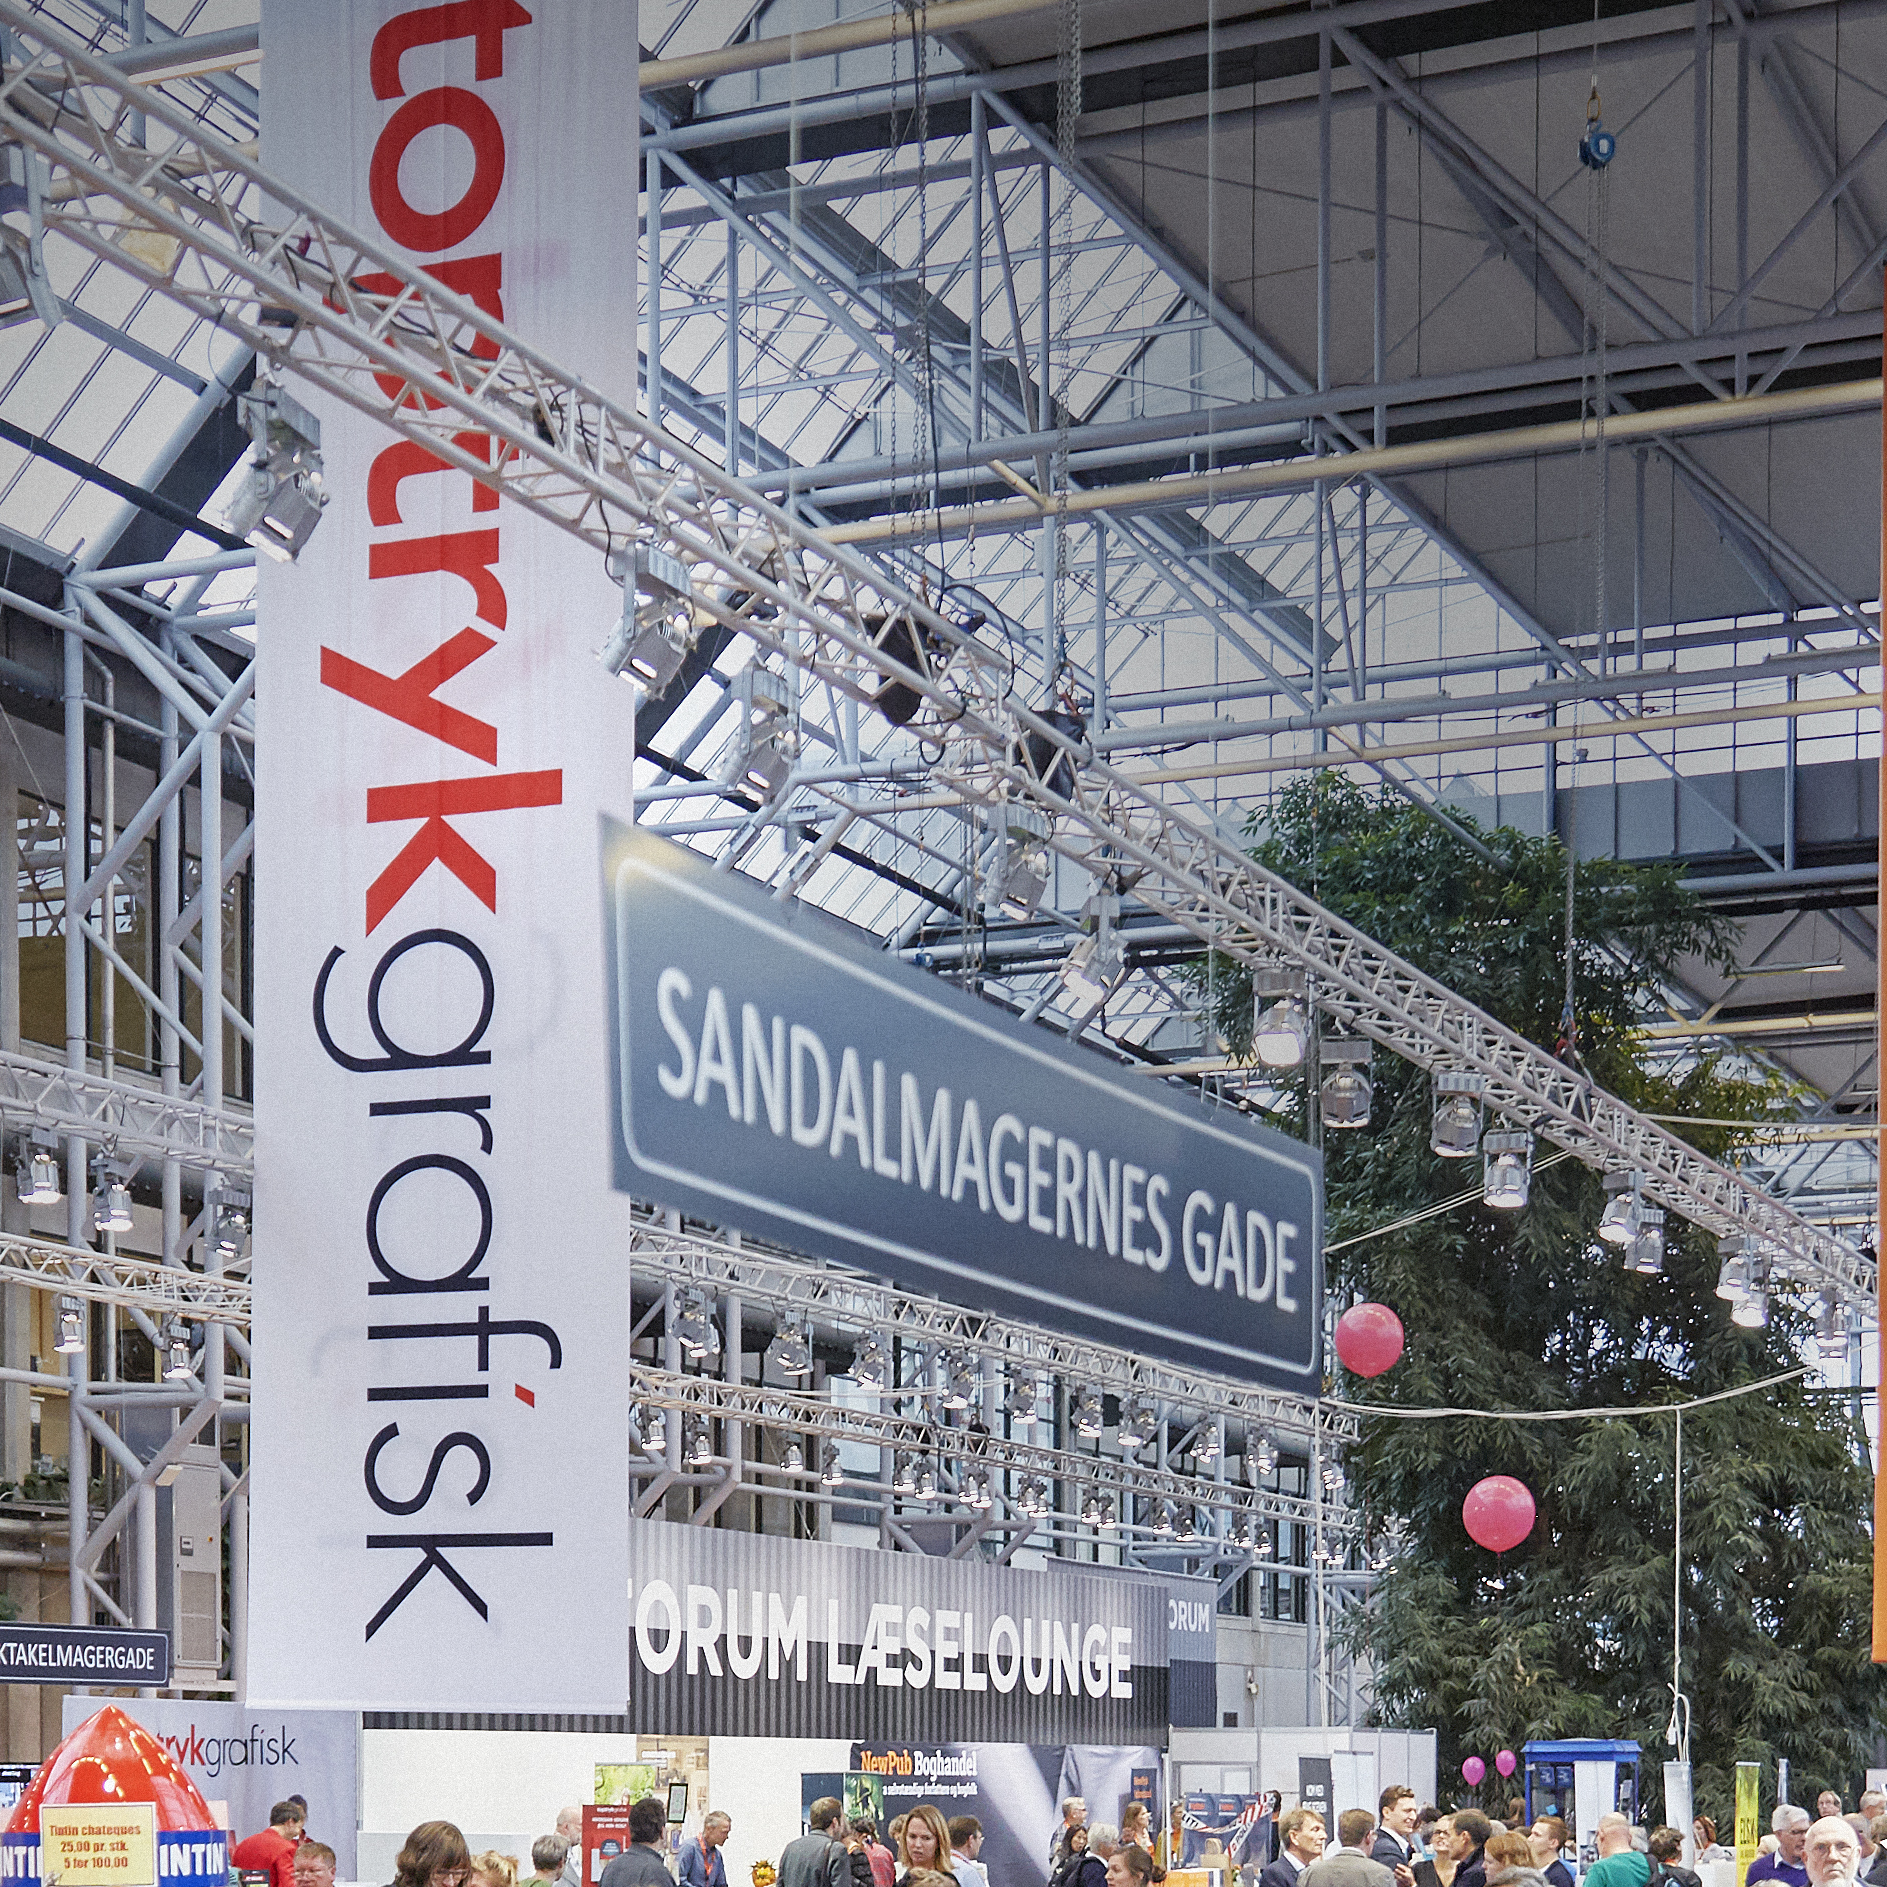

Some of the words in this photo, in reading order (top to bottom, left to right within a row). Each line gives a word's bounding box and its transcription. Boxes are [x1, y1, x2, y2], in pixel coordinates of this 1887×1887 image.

[656, 967, 1171, 1274] SANDALMAGERNES
[1182, 1190, 1299, 1313] GADE
[627, 1578, 808, 1683] ORUM
[826, 1597, 1134, 1700] LÆSELOUNGE
[860, 1748, 913, 1776] NewPub
[913, 1749, 978, 1782] Boghandel
[50, 1824, 79, 1836] Tintin
[64, 1857, 71, 1869] 5
[73, 1857, 89, 1869] for
